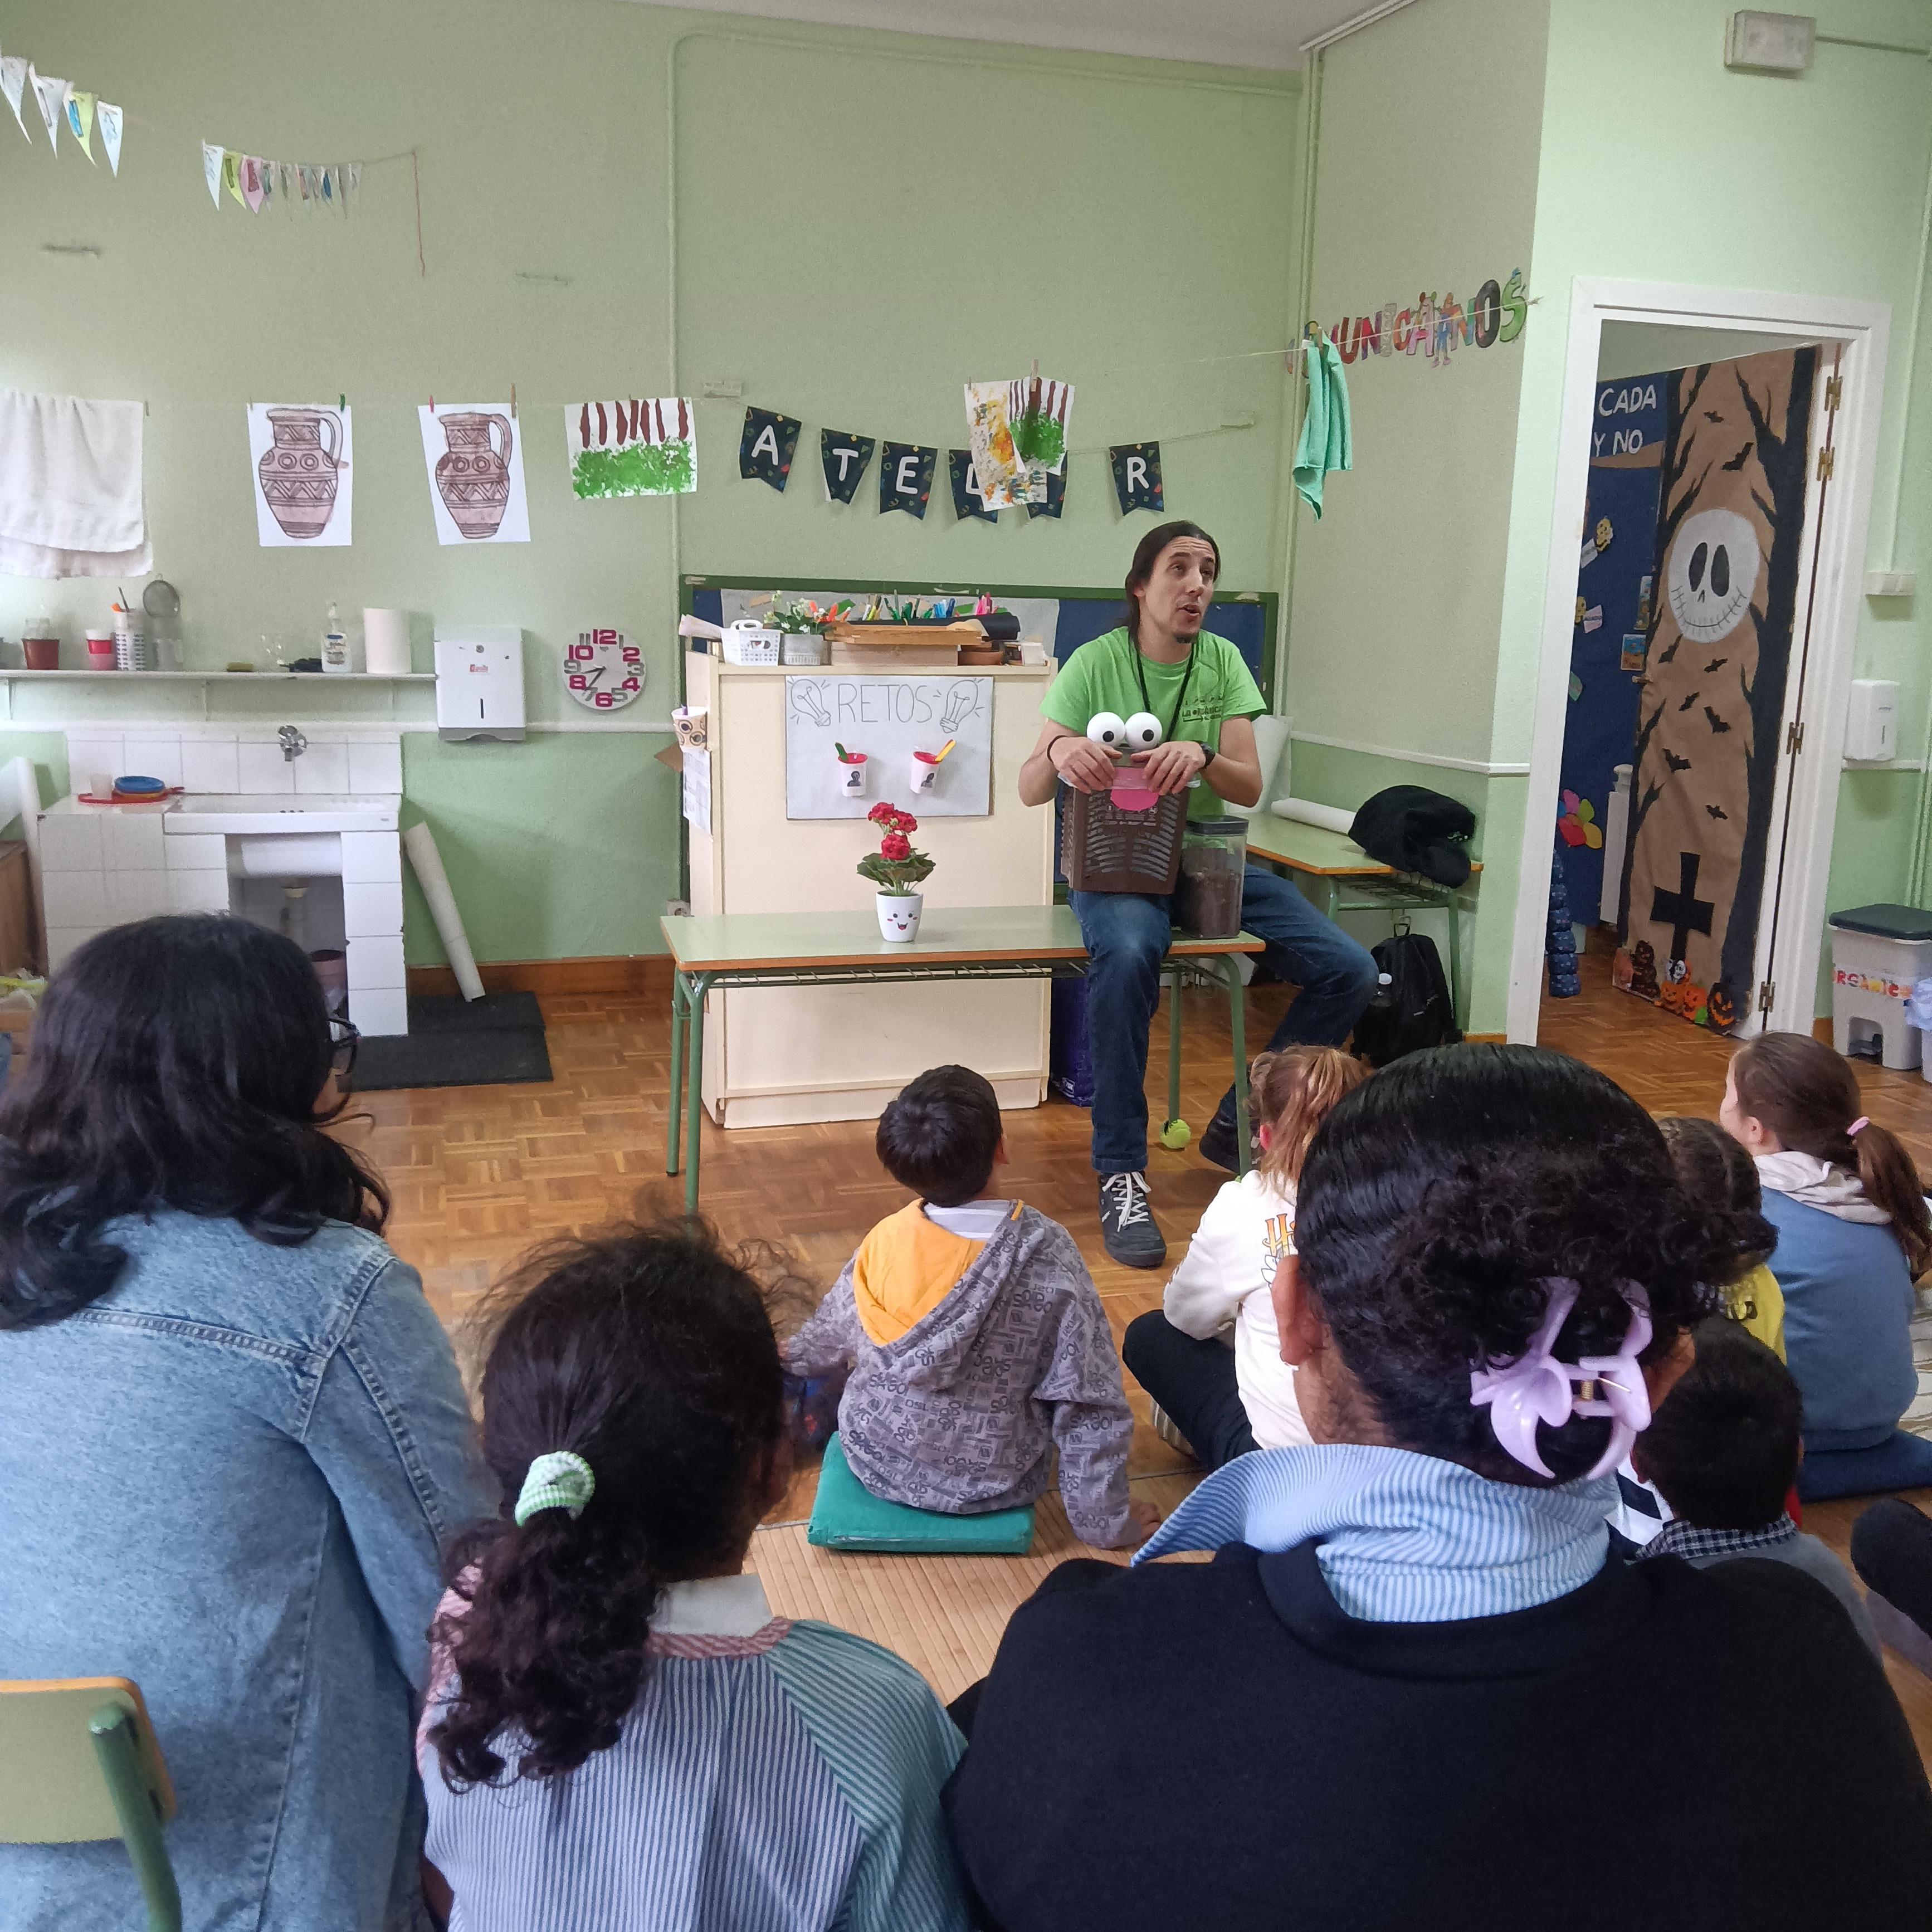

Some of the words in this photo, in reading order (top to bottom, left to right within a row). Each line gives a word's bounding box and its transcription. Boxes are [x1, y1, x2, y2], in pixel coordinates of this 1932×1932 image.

[1596, 384, 1656, 417] CADA
[1612, 430, 1643, 455] NO
[593, 629, 617, 645] 12
[569, 645, 594, 660] 10
[623, 647, 640, 662] 2
[564, 660, 582, 674] 9
[627, 662, 645, 676] 3
[569, 675, 587, 690] 8
[622, 677, 641, 691] 4
[596, 692, 612, 707] 6
[611, 687, 628, 702] 5
[837, 683, 933, 724] RETOS
[1262, 1213, 1295, 1258] H
